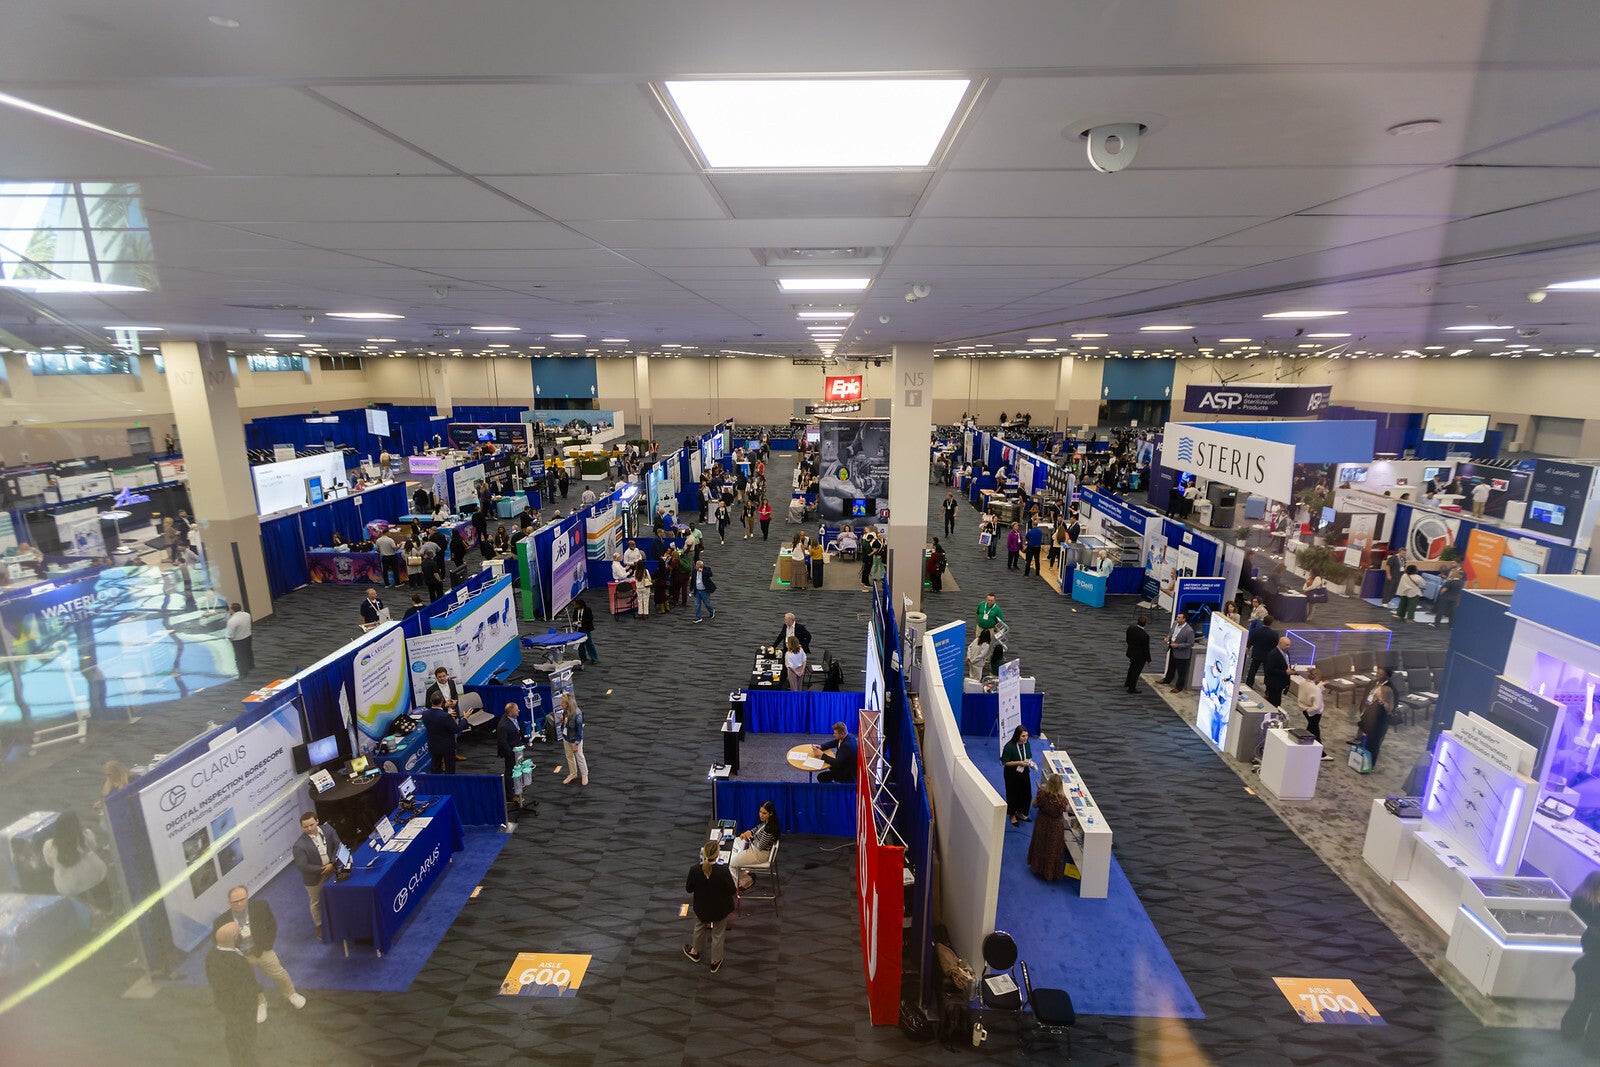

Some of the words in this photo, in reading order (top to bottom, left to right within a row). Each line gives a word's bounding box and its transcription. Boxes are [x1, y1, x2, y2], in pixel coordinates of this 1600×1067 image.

[207, 371, 226, 385] N7
[831, 379, 860, 399] Epic
[904, 372, 925, 387] N5
[1198, 391, 1243, 410] ASP
[1196, 441, 1267, 484] STERIS
[1460, 728, 1479, 742] Surgical
[1479, 739, 1509, 761] Instruments
[1463, 737, 1491, 758] Sterilization
[1490, 753, 1512, 772] Products
[191, 745, 247, 789] CLARUS
[165, 806, 199, 832] DIGITAL
[199, 775, 244, 809] INSPECTION
[244, 746, 284, 779] BORESCOPE
[192, 807, 213, 823] hiding
[213, 795, 231, 809] inside
[231, 785, 245, 798] your
[408, 846, 440, 891] CLARUS
[518, 967, 571, 987] 600
[1298, 993, 1360, 1014] 700
